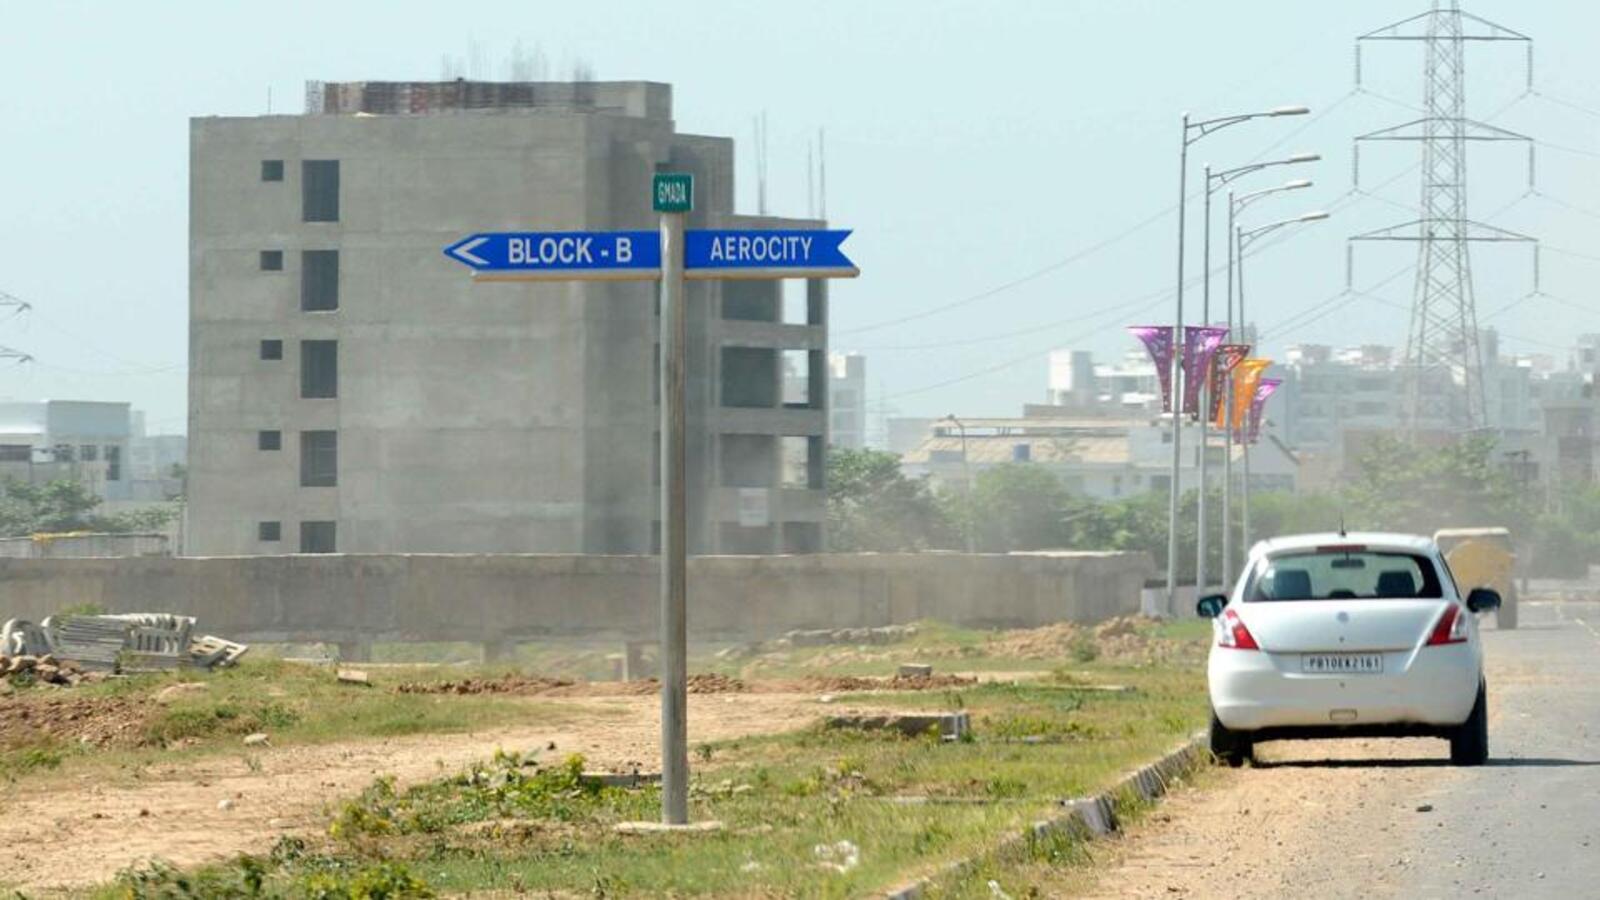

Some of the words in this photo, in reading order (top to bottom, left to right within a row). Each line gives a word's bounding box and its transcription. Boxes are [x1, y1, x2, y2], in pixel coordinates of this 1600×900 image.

[658, 181, 687, 204] GMADA
[508, 237, 592, 263] BLOCK
[616, 237, 632, 262] B
[710, 236, 813, 261] AEROCITY
